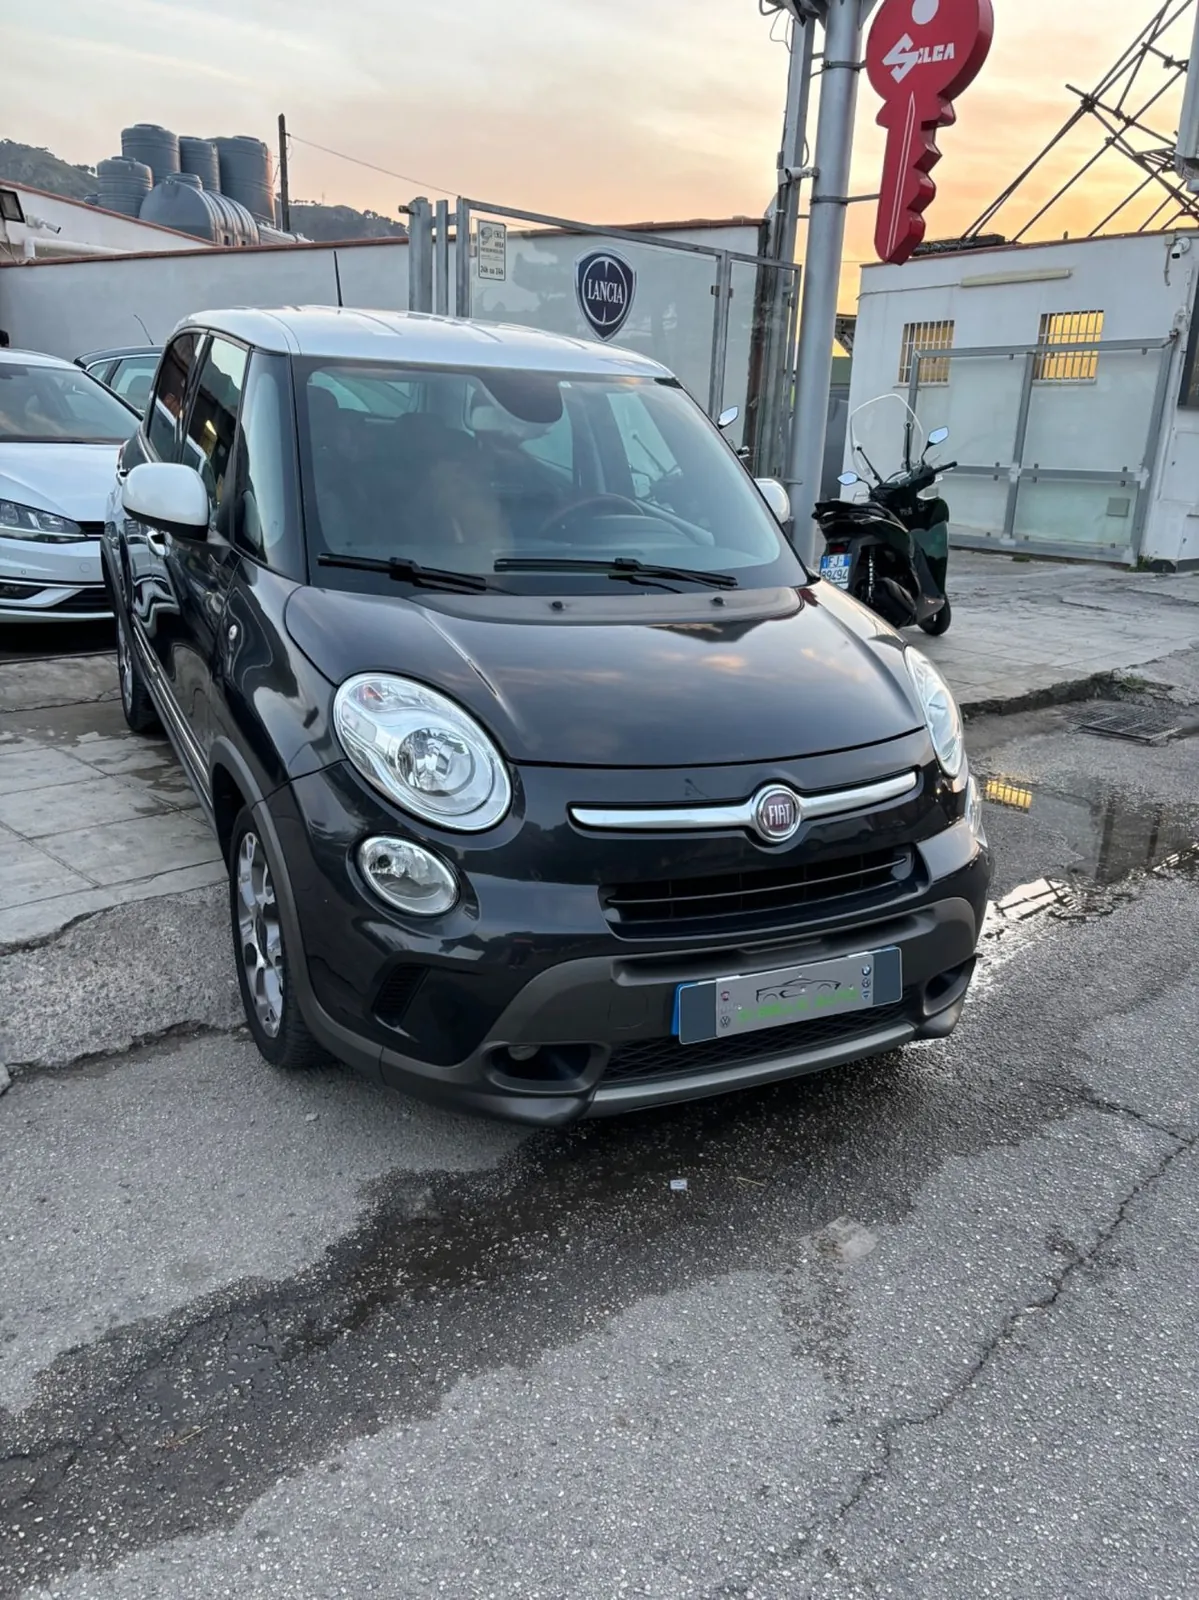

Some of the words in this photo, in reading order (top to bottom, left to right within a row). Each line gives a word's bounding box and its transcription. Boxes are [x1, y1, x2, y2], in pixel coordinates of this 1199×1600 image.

[882, 32, 955, 84] SILCA
[587, 279, 624, 304] LANCIA
[768, 803, 790, 826] FIAT
